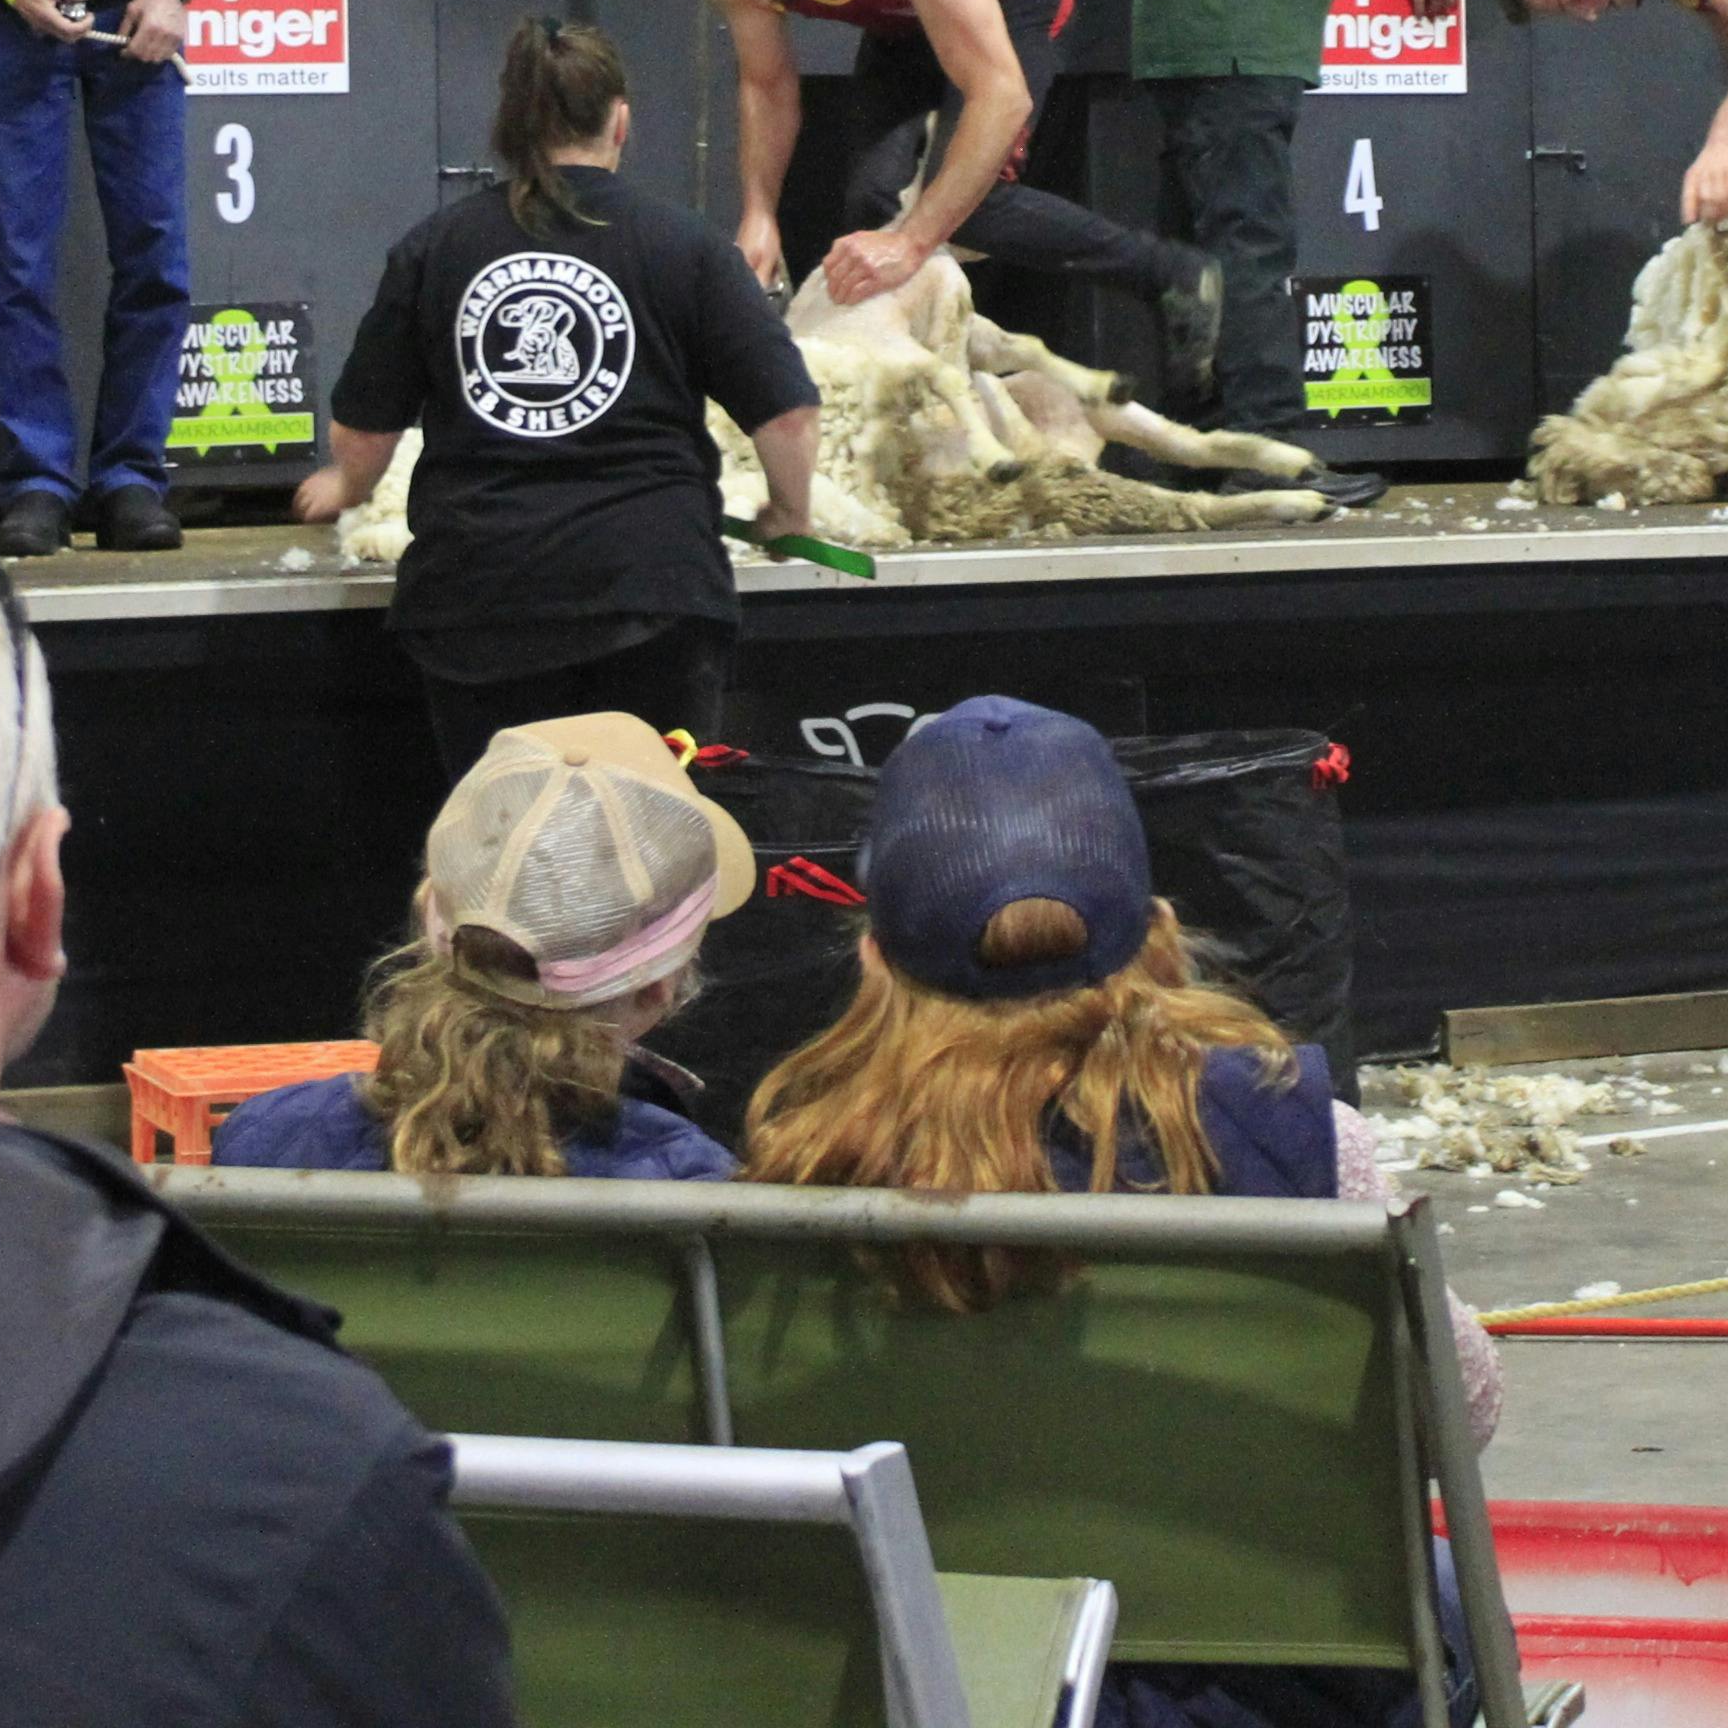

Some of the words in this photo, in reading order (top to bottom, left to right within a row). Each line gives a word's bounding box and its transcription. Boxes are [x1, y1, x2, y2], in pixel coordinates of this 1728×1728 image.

[196, 68, 249, 87] sults
[256, 69, 328, 87] matter
[1321, 69, 1378, 89] esults
[1385, 71, 1449, 87] matter
[214, 122, 256, 224] 3
[1344, 138, 1384, 232] 4
[460, 258, 627, 340] WARRNAMBOOL
[1307, 291, 1417, 318] MUSCULAR
[1306, 318, 1419, 345] DYSTROPHY
[1304, 345, 1422, 373] AWARENESS
[506, 368, 619, 431] SHEARS
